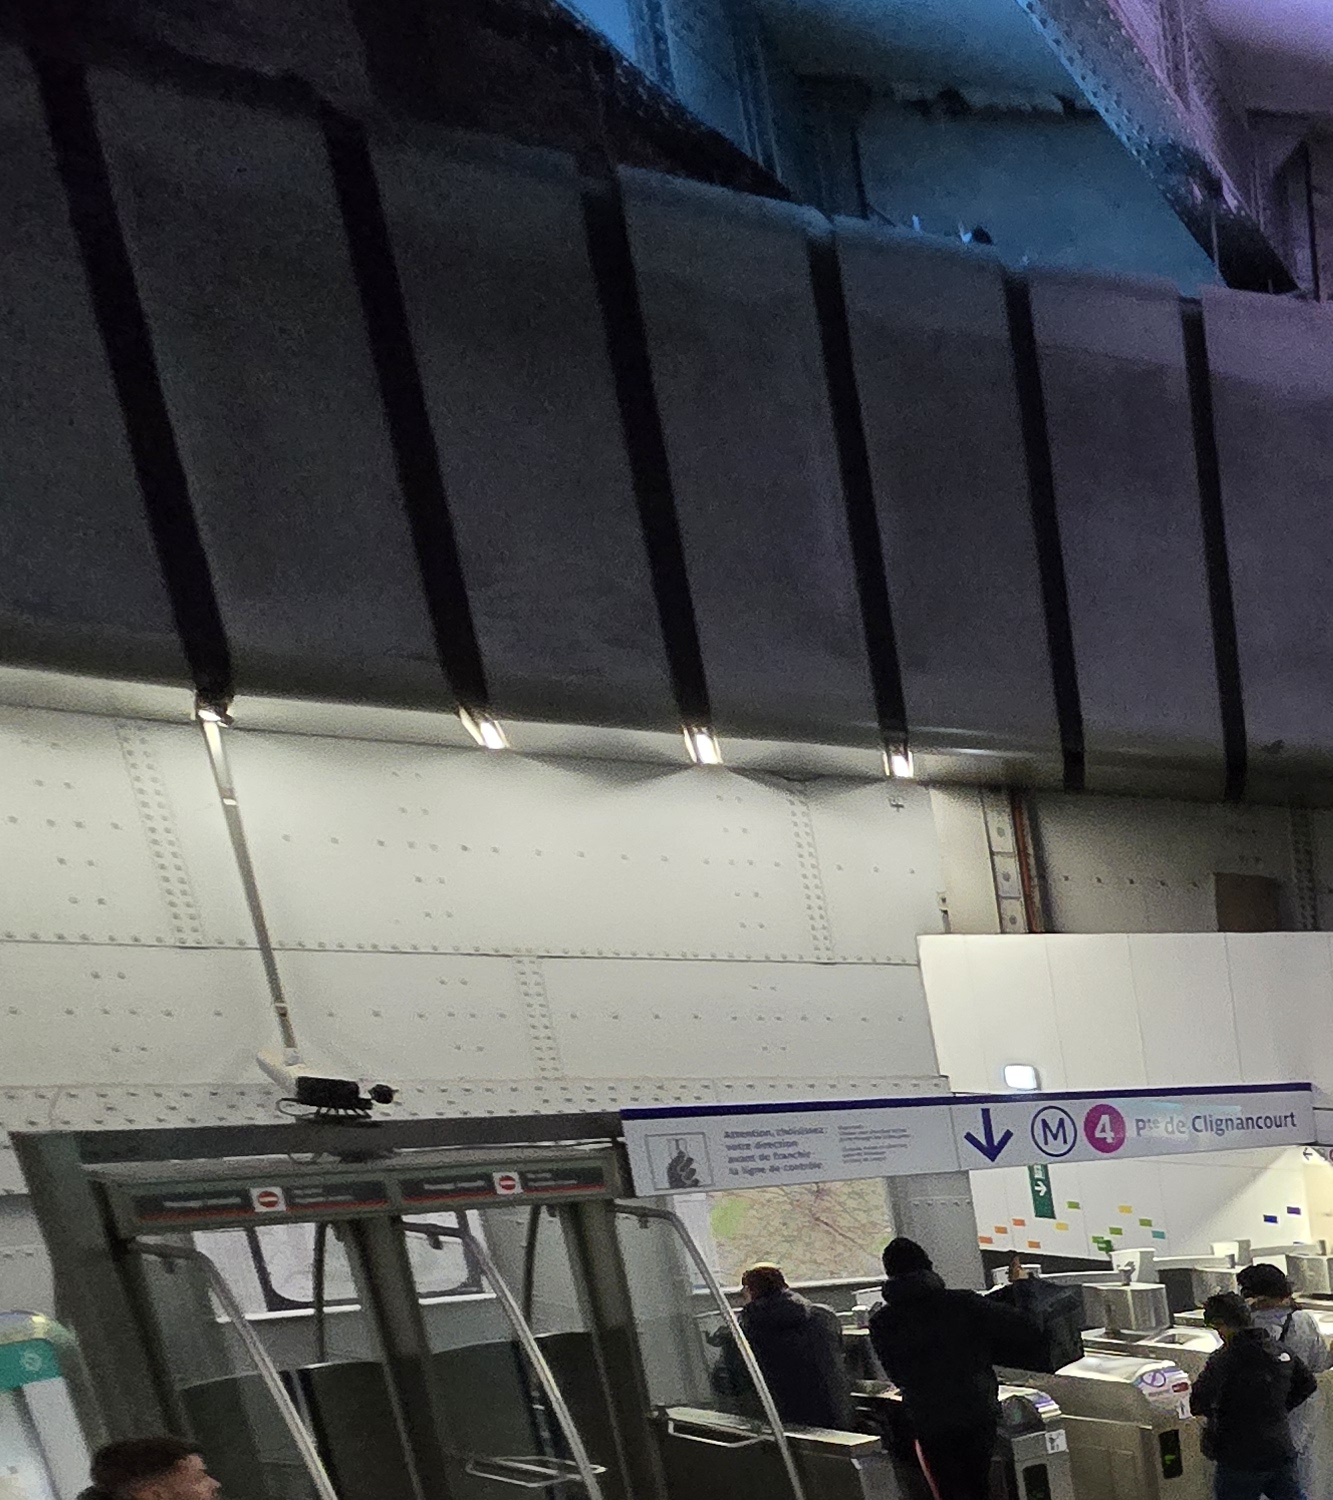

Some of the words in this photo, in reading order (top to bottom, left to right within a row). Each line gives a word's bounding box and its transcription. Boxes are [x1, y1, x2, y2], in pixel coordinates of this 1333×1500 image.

[1095, 1114, 1113, 1143] 4
[1164, 1114, 1186, 1134] de
[1191, 1111, 1297, 1138] Clignancourt
